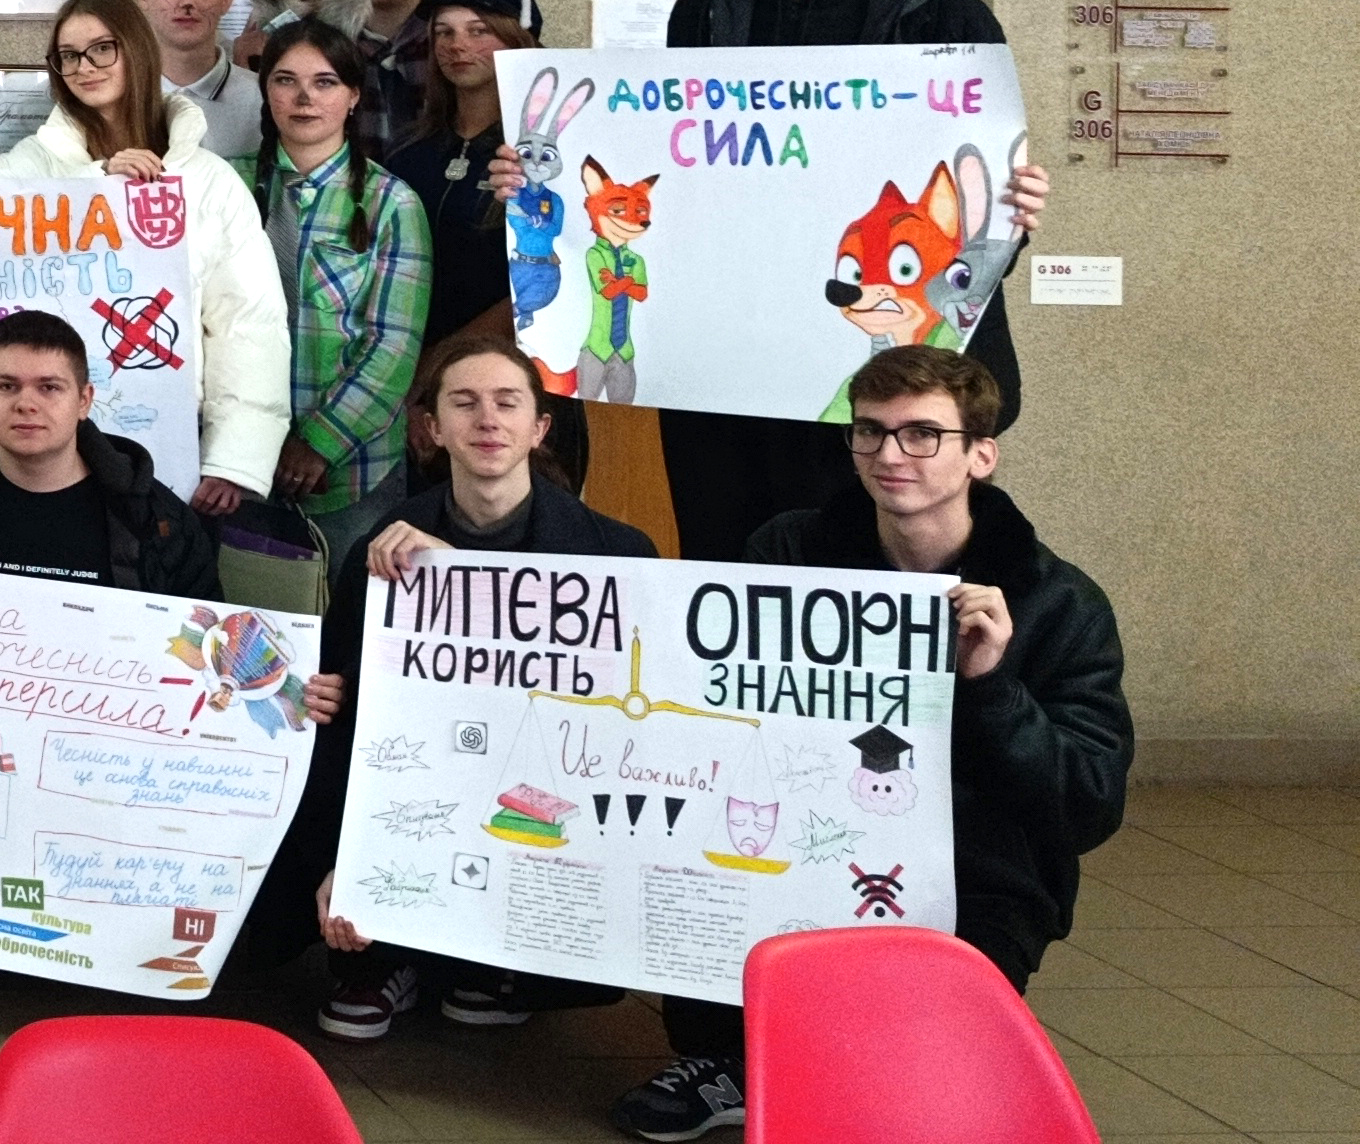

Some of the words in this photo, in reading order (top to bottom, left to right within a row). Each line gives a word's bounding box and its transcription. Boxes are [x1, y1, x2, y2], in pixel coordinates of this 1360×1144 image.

[1075, 6, 1114, 24] 306
[608, 77, 886, 113] ДОБРОЧЕСНІСТЬ
[926, 77, 984, 115] ЦЕ
[1083, 90, 1102, 111] G
[1074, 120, 1113, 138] 306
[668, 118, 809, 170] СИЛА
[1038, 265, 1047, 274] G
[1050, 265, 1072, 274] 306
[26, 565, 70, 575] DEFINITELY
[71, 570, 98, 579] JUDGE
[383, 564, 624, 653] МИТТЄВА
[402, 639, 596, 697] КОРИСТЬ
[703, 662, 911, 727] ЗНАННЯ
[50, 736, 130, 766] Чесність
[141, 757, 154, 773] у
[163, 758, 253, 777] навчанні
[558, 719, 607, 779] Це
[617, 745, 721, 795] важливо!
[74, 769, 93, 786] це
[168, 779, 272, 802] справжніх
[125, 788, 185, 807] знань
[38, 841, 103, 877] Будуй
[202, 861, 229, 876] на
[3, 884, 41, 904] ТАК
[149, 881, 164, 893] а
[174, 881, 197, 895] не
[210, 883, 237, 896] на
[13, 925, 37, 937] освіта
[31, 910, 93, 935] культура
[185, 917, 204, 936] НІ
